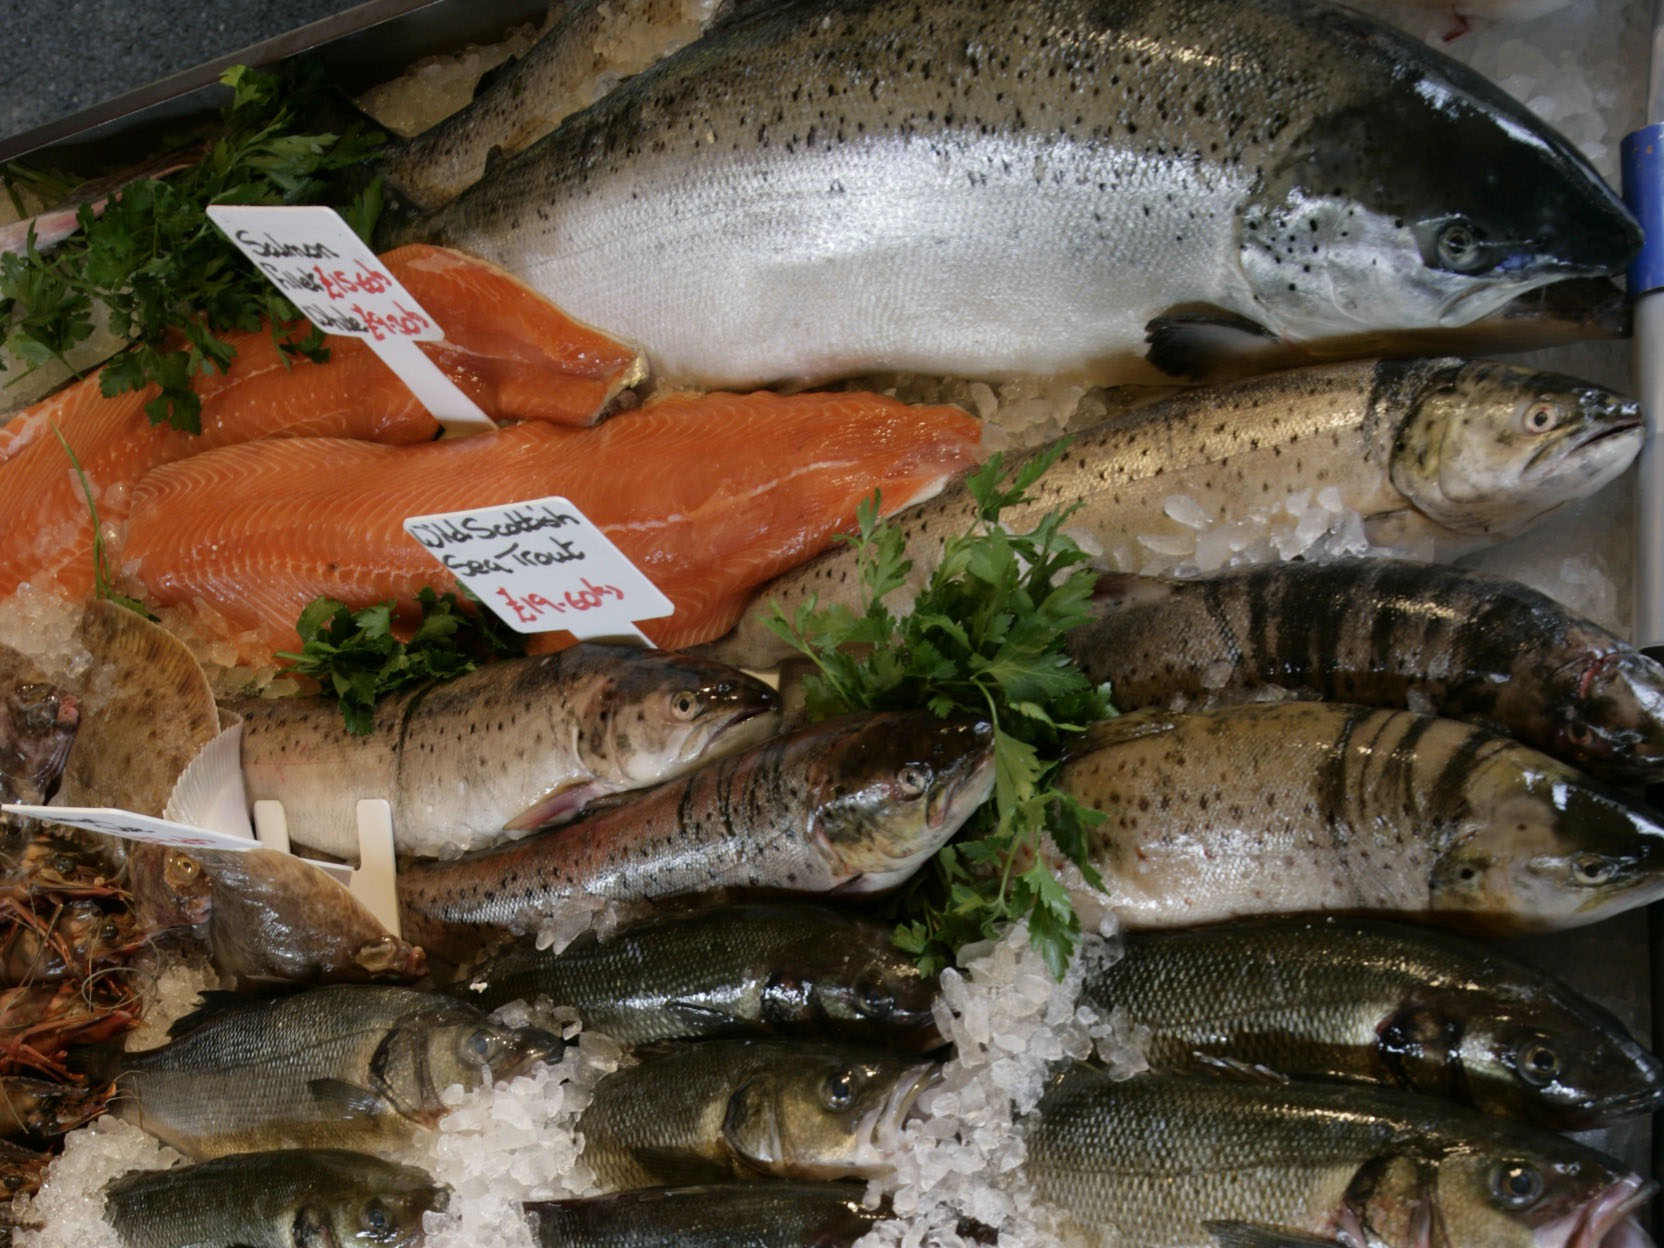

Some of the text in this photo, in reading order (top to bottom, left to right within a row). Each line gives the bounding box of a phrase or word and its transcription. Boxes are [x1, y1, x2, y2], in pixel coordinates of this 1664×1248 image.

[235, 230, 339, 259] Salmon
[461, 506, 580, 540] Scottish
[442, 536, 586, 577] Sea Trout
